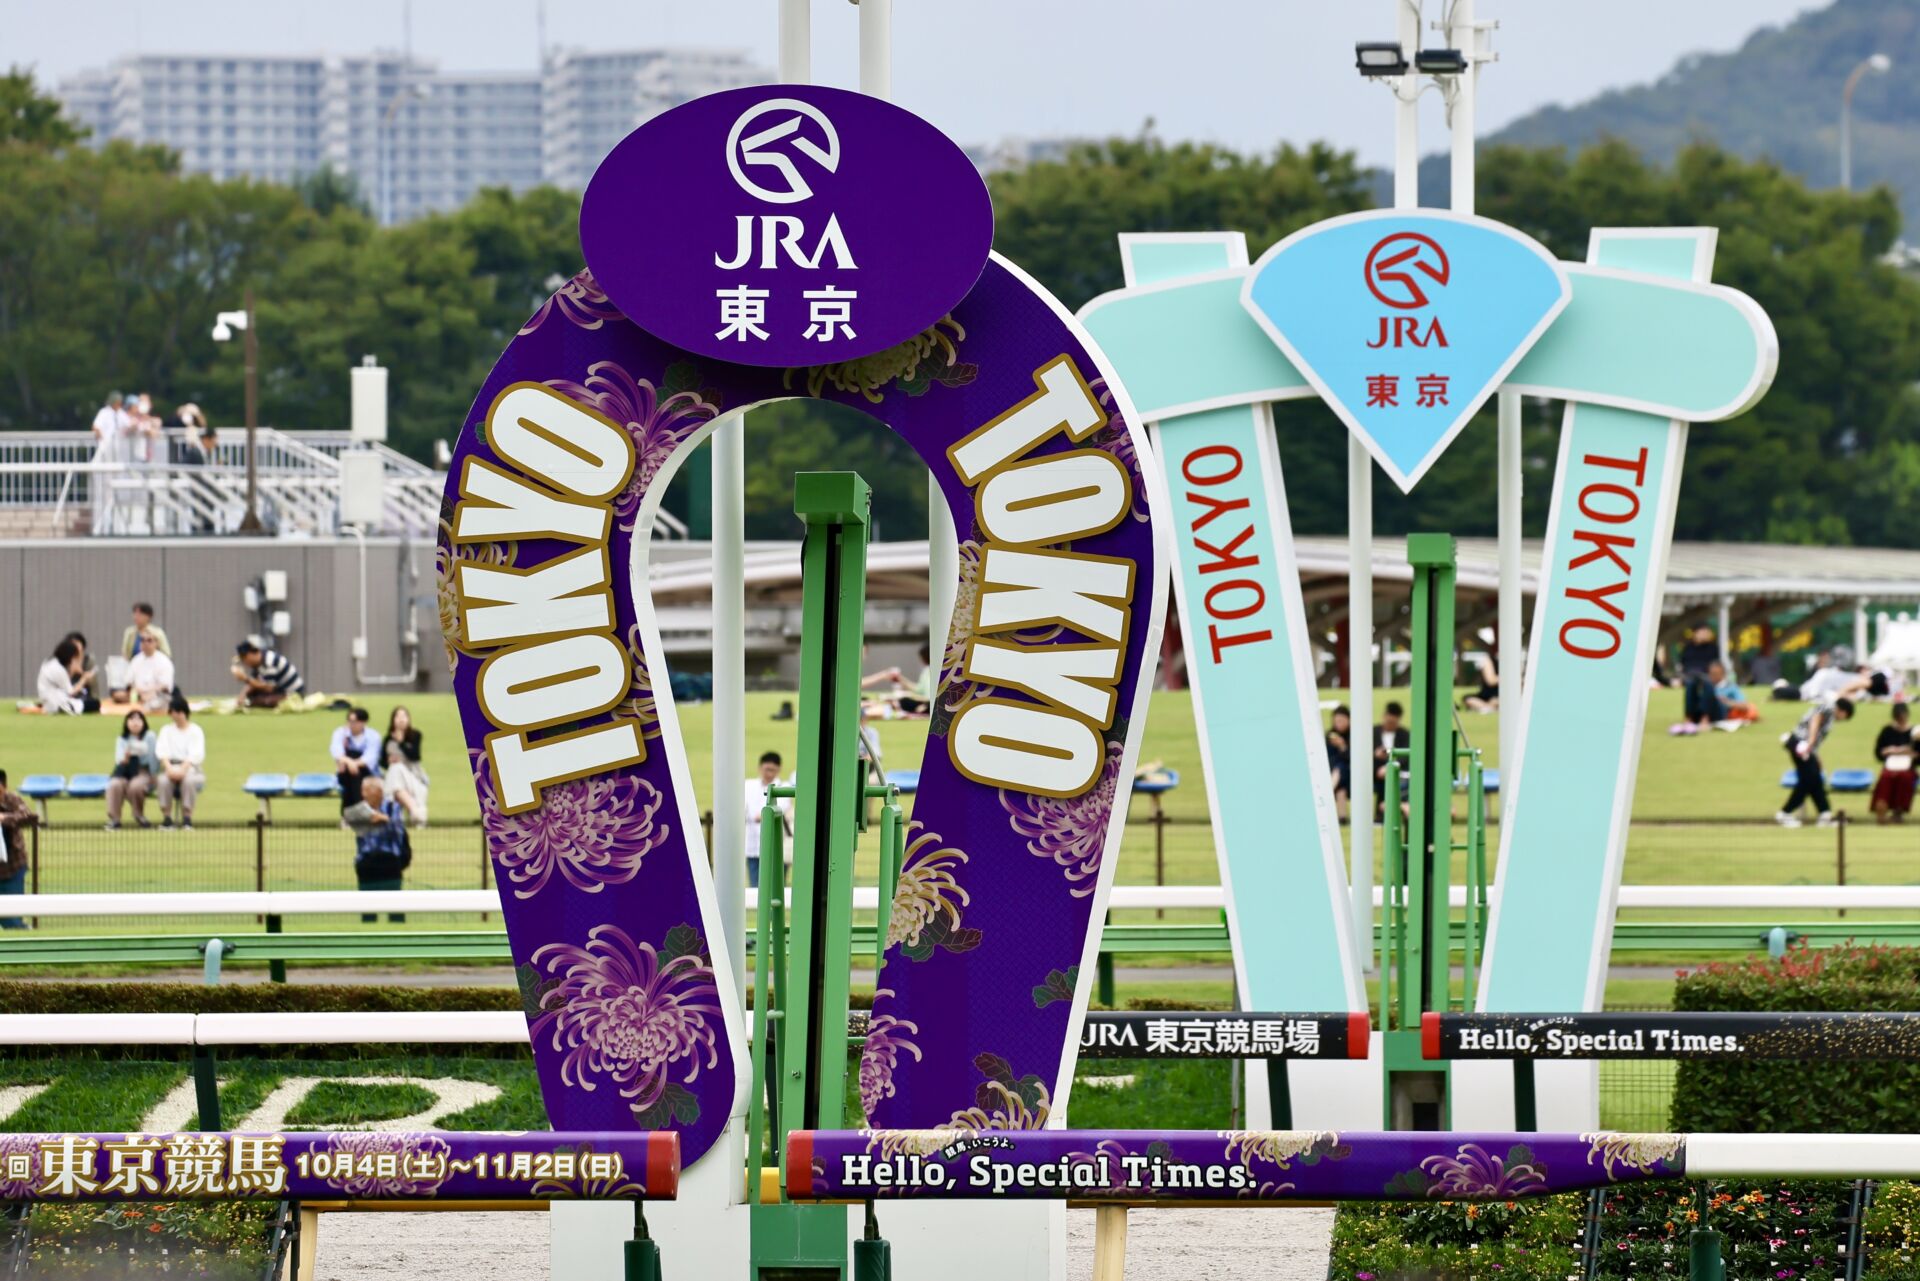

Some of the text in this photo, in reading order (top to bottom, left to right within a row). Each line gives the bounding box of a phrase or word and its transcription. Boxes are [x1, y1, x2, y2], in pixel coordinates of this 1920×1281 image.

[714, 211, 859, 270] JRA
[714, 284, 858, 342] 東京
[1366, 315, 1450, 349] JRA
[1366, 373, 1450, 408] 東京
[949, 357, 1133, 795] TOKYO
[1181, 444, 1273, 665] TOKYO
[1558, 447, 1649, 660] TOKYO
[456, 384, 643, 811] TOKYO
[1081, 1018, 1321, 1055] JRA 東京競馬場
[1459, 1028, 1745, 1056] Hello, Special Times.
[841, 1153, 1258, 1194] Hello, Special Times.
